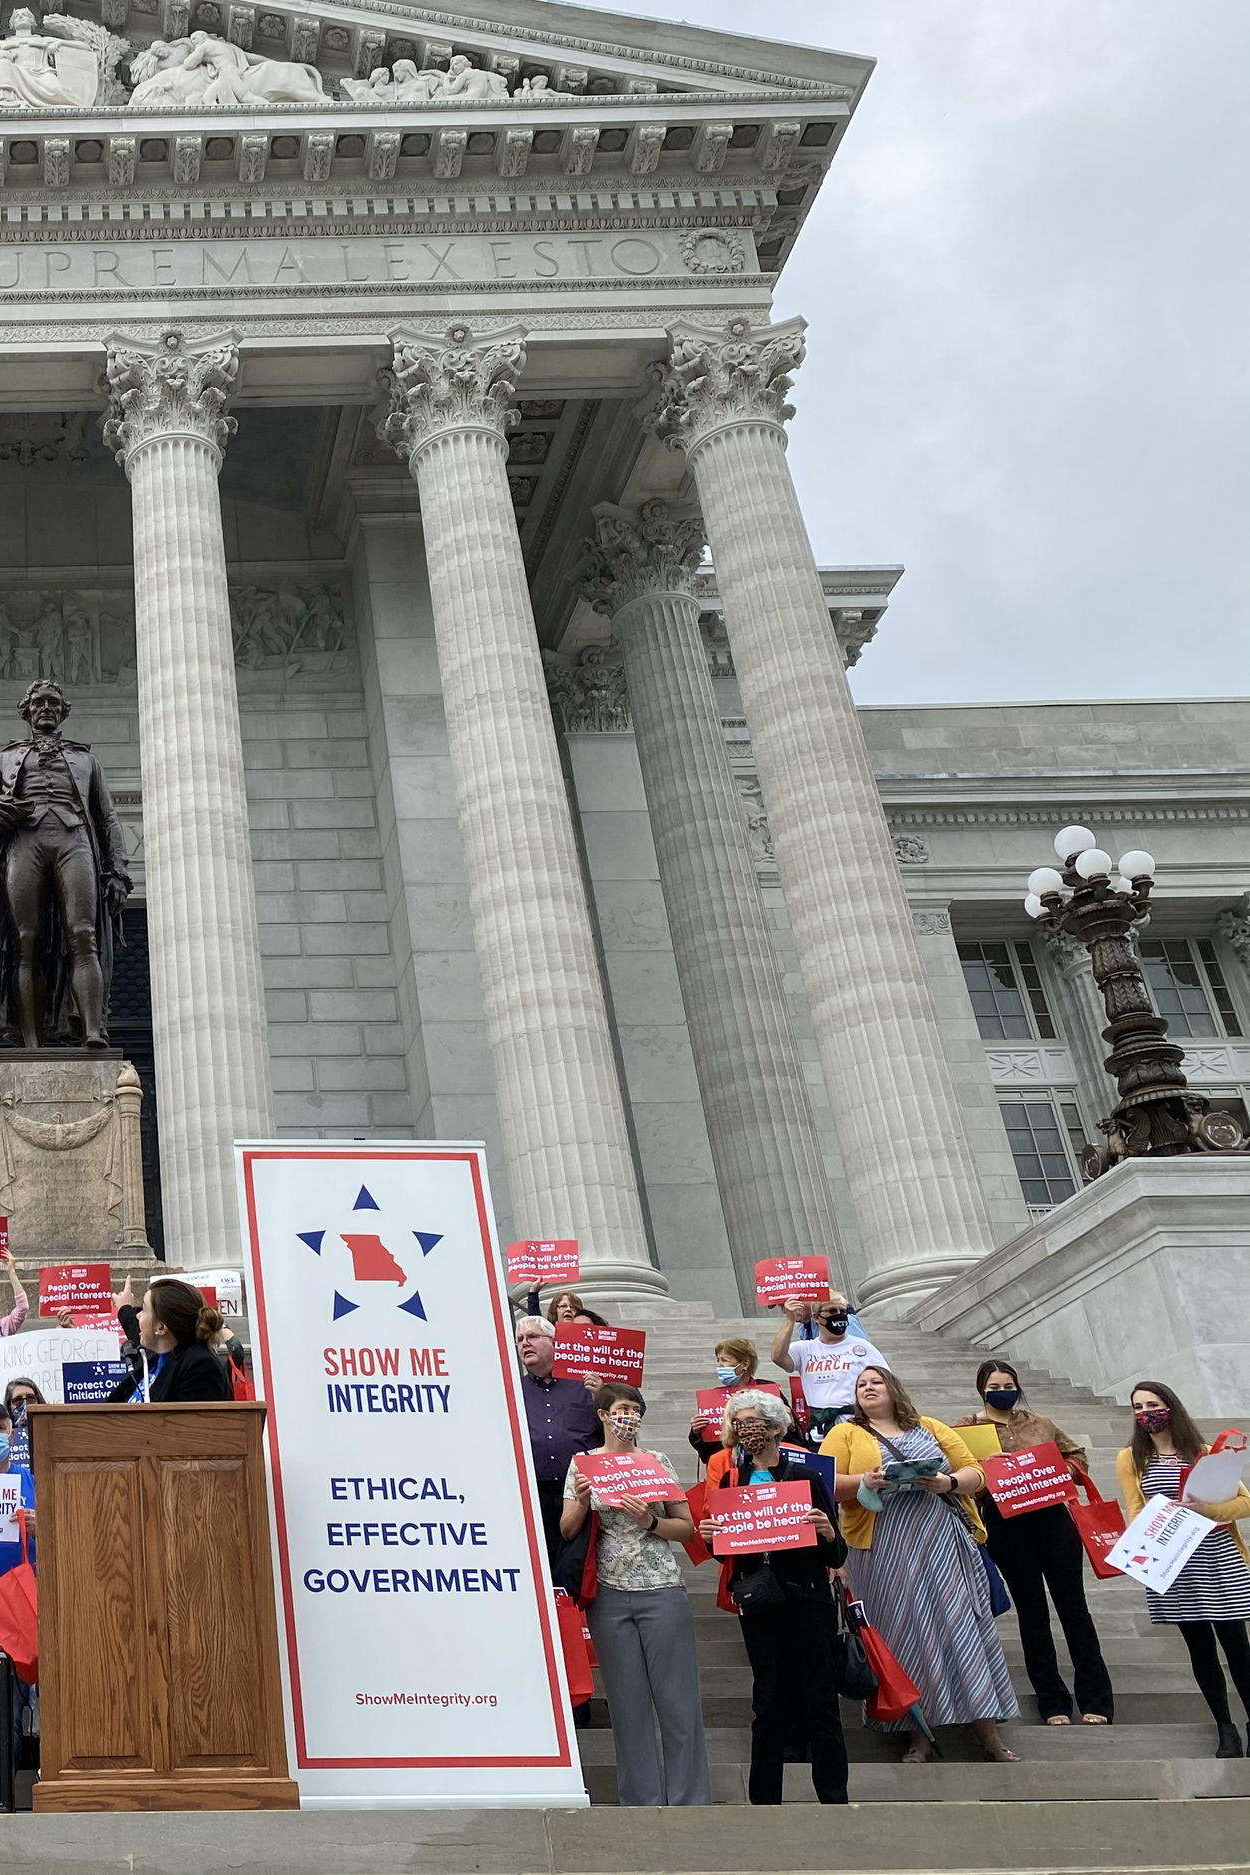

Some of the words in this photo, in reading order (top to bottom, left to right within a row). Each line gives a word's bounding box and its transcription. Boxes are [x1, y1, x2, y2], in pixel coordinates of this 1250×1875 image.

[340, 242, 464, 282] LEX
[487, 238, 661, 280] ESTO
[508, 1256, 520, 1264] Let
[521, 1254, 535, 1262] the
[508, 1263, 536, 1272] people
[764, 1273, 793, 1283] People
[48, 1283, 77, 1292] People
[78, 1282, 100, 1290] Over
[756, 1282, 787, 1293] Special
[39, 1292, 70, 1304] Special
[71, 1291, 112, 1300] Interests
[95, 1320, 109, 1328] will
[3, 1341, 33, 1369] KING
[37, 1338, 108, 1362] GEORGE
[555, 1341, 571, 1350] Let
[573, 1343, 590, 1352] the
[592, 1345, 610, 1354] will
[612, 1347, 624, 1356] of
[626, 1349, 643, 1358] the
[323, 1347, 400, 1376] SHOW
[409, 1348, 449, 1376] ME
[554, 1352, 590, 1363] people
[592, 1355, 606, 1364] be
[609, 1357, 642, 1368] heard.
[67, 1380, 104, 1391] Protect
[327, 1384, 450, 1413] INTEGRITY
[593, 1471, 630, 1484] People
[631, 1468, 656, 1477] Over
[630, 1477, 675, 1488] Interests
[997, 1471, 1032, 1488] People
[1032, 1466, 1056, 1477] Over
[2, 1488, 17, 1500] ME
[330, 1477, 465, 1504] ETHICAL,
[992, 1485, 1029, 1502] Special
[1030, 1473, 1072, 1491] Interests
[731, 1510, 752, 1521] the
[753, 1505, 773, 1518] will
[775, 1503, 788, 1515] of
[790, 1502, 812, 1512] the
[756, 1519, 771, 1530] be
[1144, 1513, 1168, 1539] SHOW
[1156, 1508, 1191, 1547] INTEGRITY
[327, 1522, 488, 1546] EFFECTIVE
[730, 1534, 799, 1547] ShowMeIntegrity.org
[1160, 1526, 1201, 1578] ShowMeIntegrity.org
[303, 1568, 521, 1593] GOVERNMENT
[355, 1693, 497, 1707] ShowMeIntegrity.org
